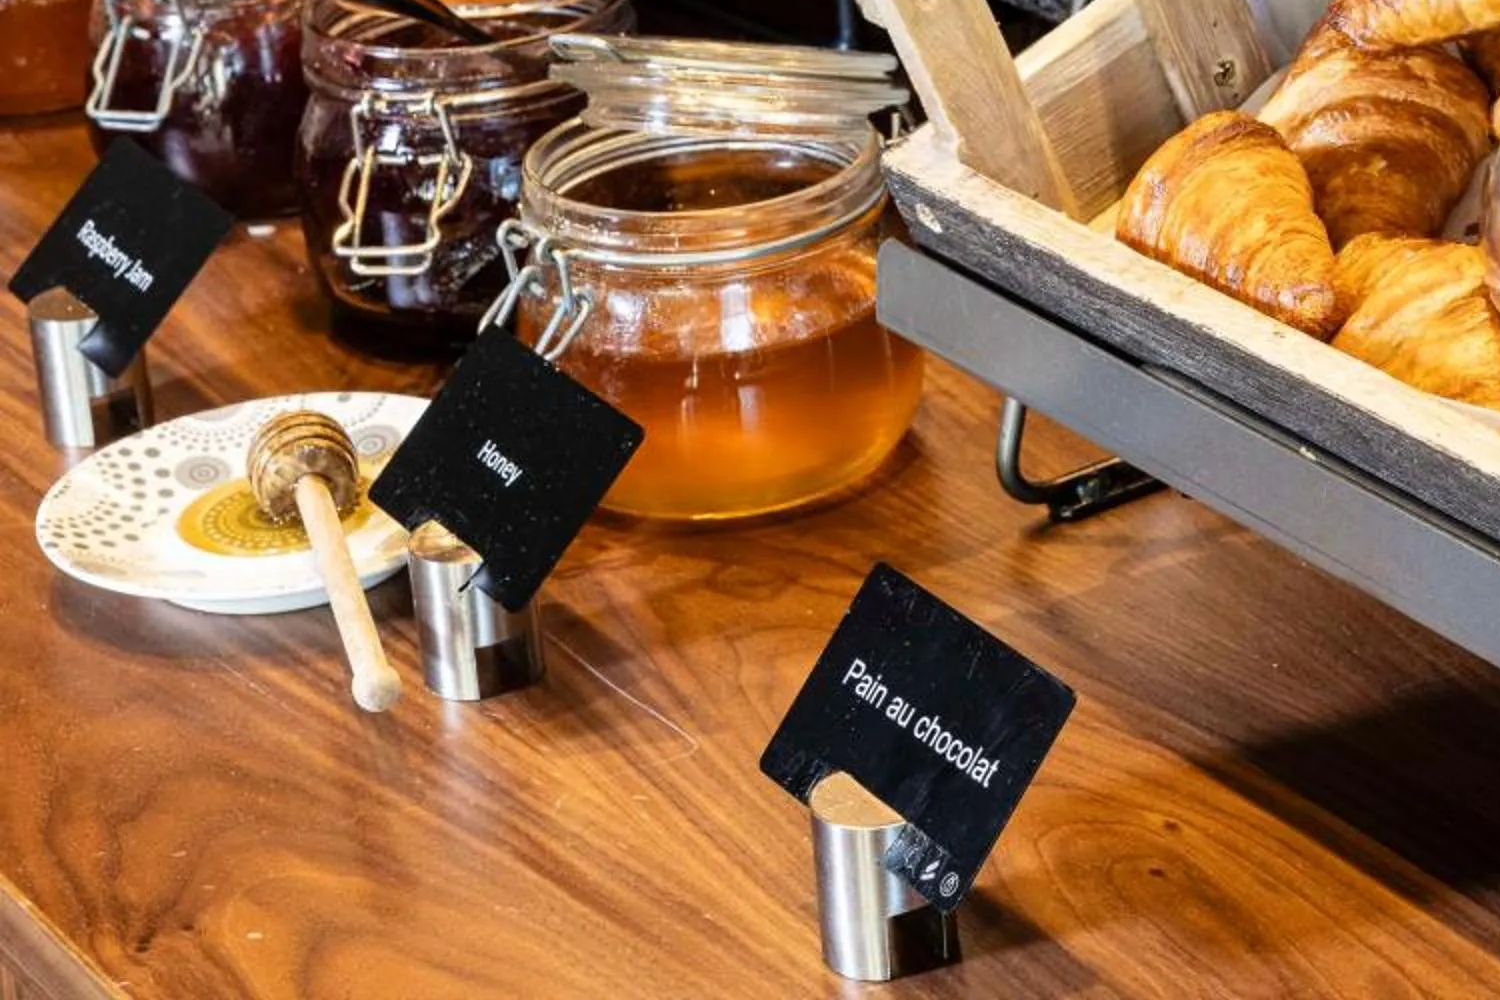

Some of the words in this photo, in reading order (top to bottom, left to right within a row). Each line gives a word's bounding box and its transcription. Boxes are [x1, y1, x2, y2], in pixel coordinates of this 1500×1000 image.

[76, 219, 134, 279] Raspberry
[123, 258, 153, 292] Jam
[476, 439, 523, 488] Honey
[841, 657, 888, 709] Pain
[885, 695, 917, 729] au
[913, 715, 1001, 789] chocolat
